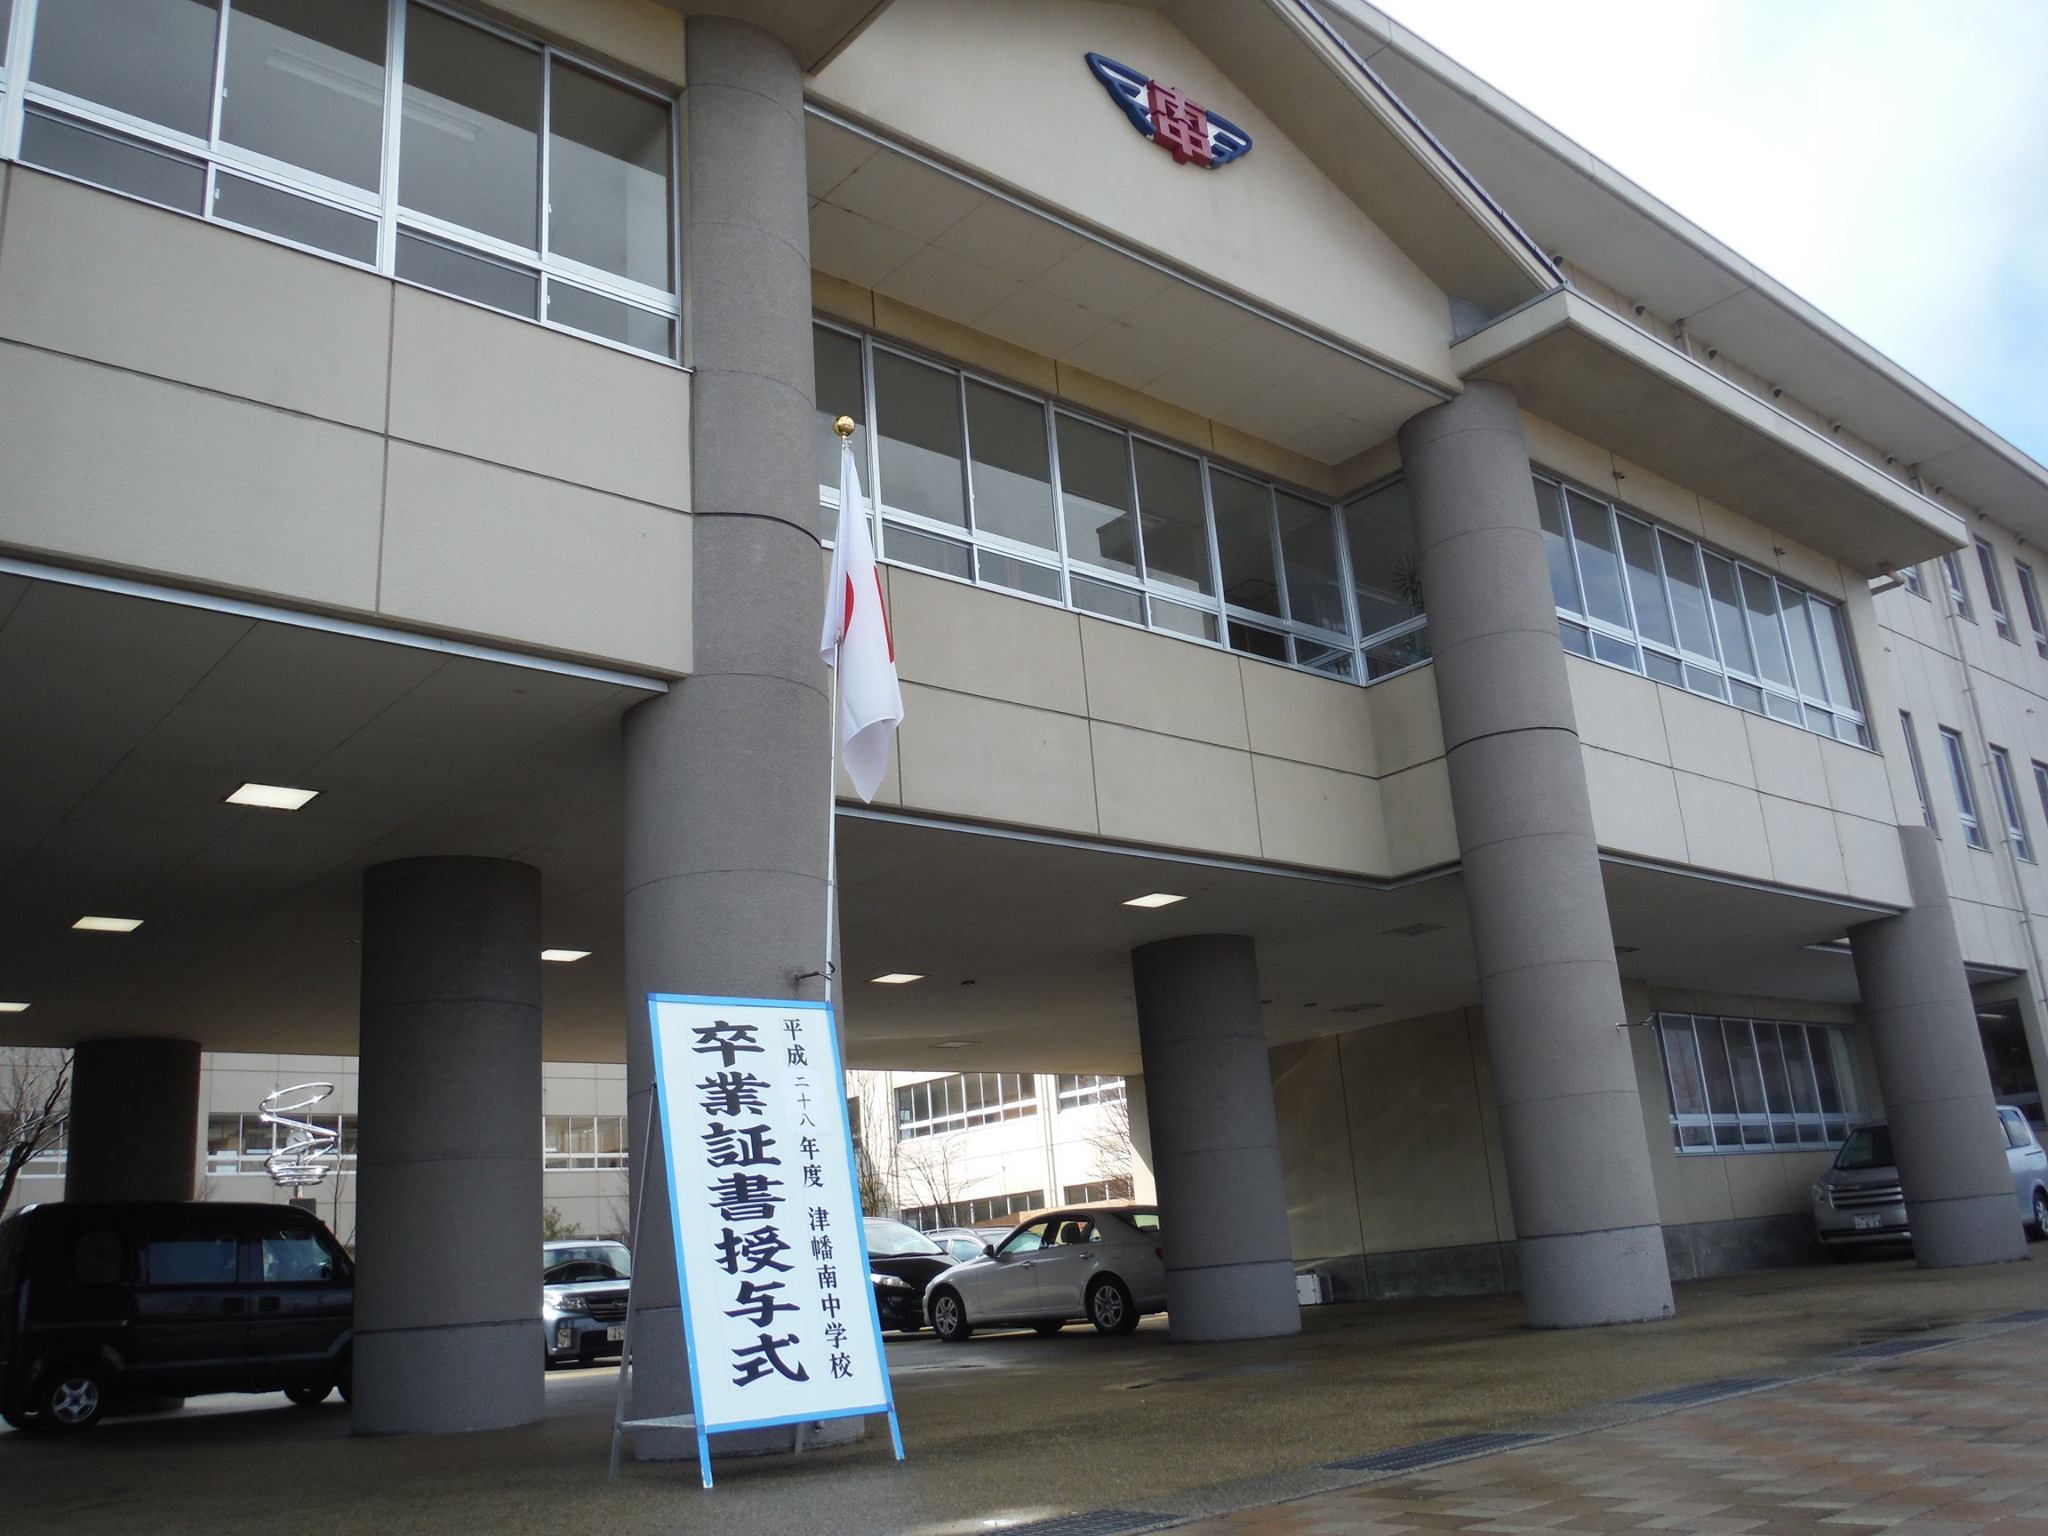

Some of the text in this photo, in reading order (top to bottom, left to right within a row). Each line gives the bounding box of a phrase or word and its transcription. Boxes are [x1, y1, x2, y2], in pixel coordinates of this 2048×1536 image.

[691, 1020, 809, 1387] 卒業証書授与式
[783, 1018, 853, 1380] 平成二十八年度 津幡南中学校
